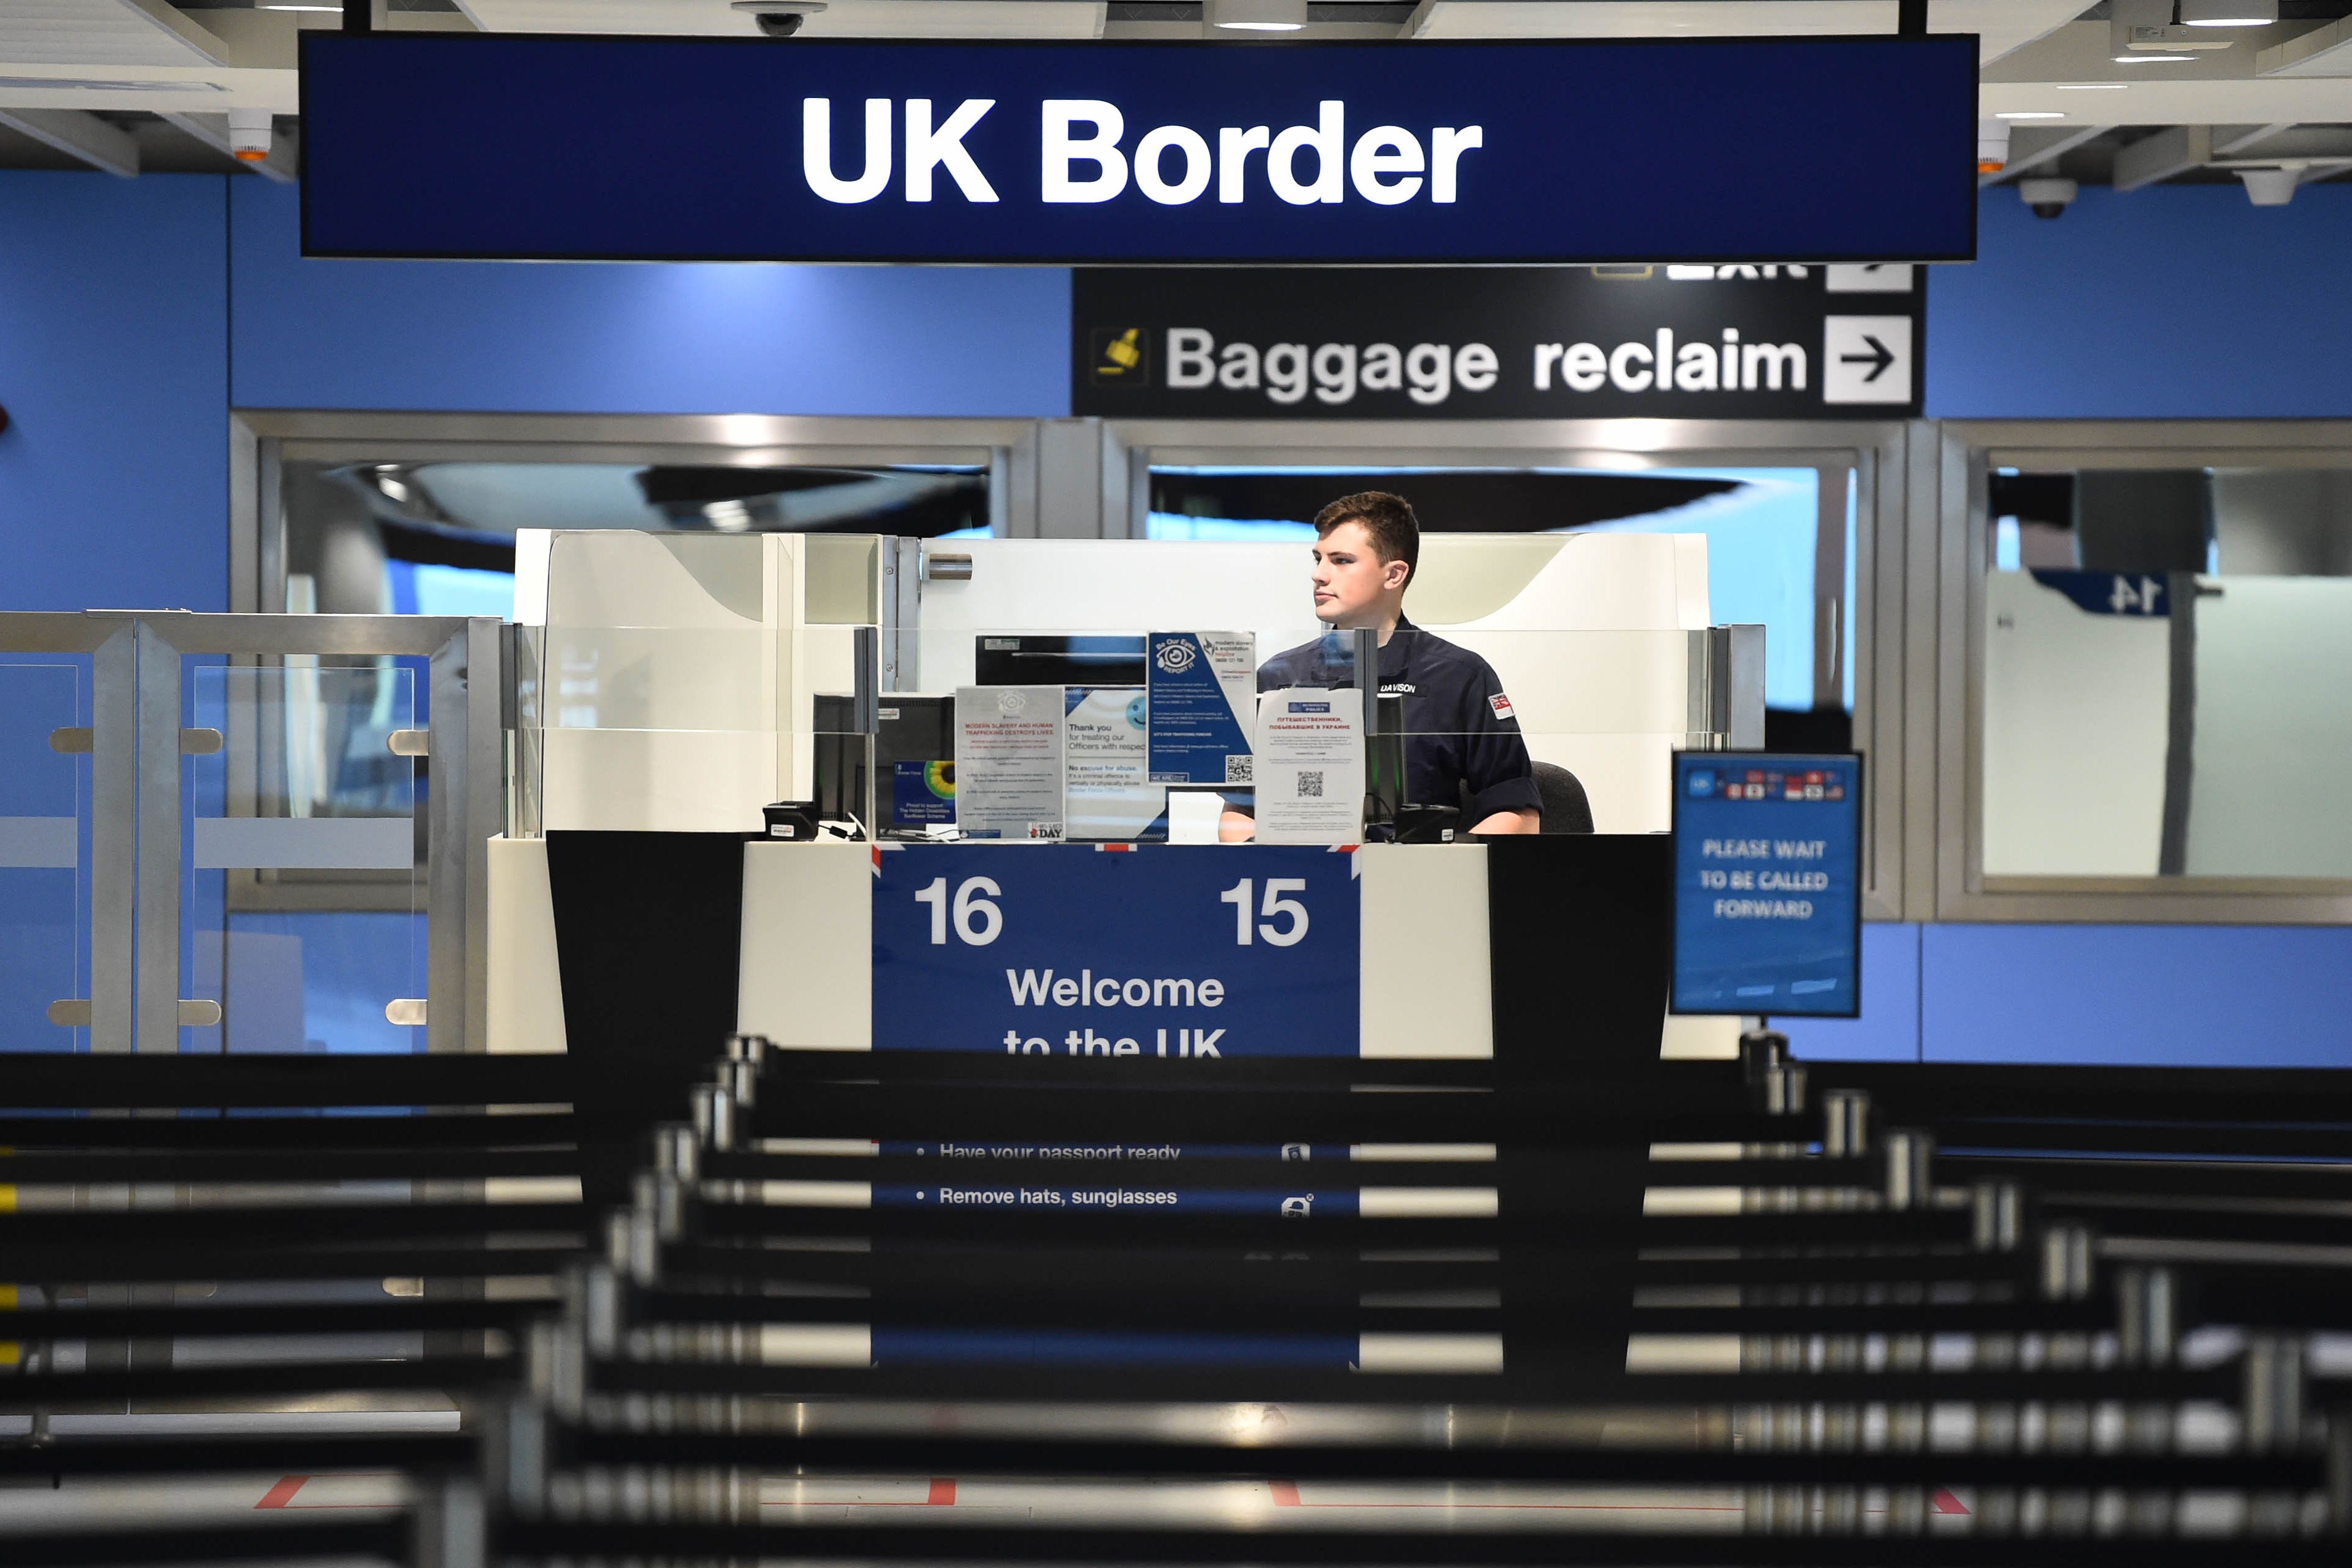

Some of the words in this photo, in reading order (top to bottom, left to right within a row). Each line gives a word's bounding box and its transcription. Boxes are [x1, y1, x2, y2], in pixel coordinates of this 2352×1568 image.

[803, 97, 1000, 205] UK
[1042, 99, 1483, 206] Border
[1166, 327, 1500, 404] Baggage
[1534, 327, 1808, 391] reclaim
[1156, 642, 1166, 651] Be
[1180, 639, 1196, 651] Eyes
[1381, 683, 1416, 693] DAVISON
[1069, 724, 1095, 732] Thank
[1082, 733, 1110, 742] treating
[1069, 742, 1100, 750] Officers
[1119, 743, 1146, 751] respec
[1039, 829, 1063, 838] DAY
[1702, 839, 1770, 859] PLEASE
[1773, 839, 1827, 860] WAIT
[1701, 870, 1726, 889] TO
[1729, 870, 1755, 891] BE
[1758, 871, 1829, 891] CALLED
[915, 876, 1003, 947] 16
[1220, 878, 1310, 947] 15
[1713, 899, 1814, 920] FORWARD
[1006, 968, 1225, 1008] Welcome
[1003, 1029, 1050, 1056] to
[1065, 1028, 1141, 1056] the
[1157, 1029, 1227, 1059] UK
[940, 1143, 986, 1159] Have
[991, 1146, 1034, 1159] your
[1039, 1145, 1123, 1161] passport
[1127, 1145, 1182, 1161] ready
[939, 1188, 1015, 1204] Remove
[1020, 1188, 1066, 1207] hats,
[1071, 1188, 1178, 1208] sunglasses
